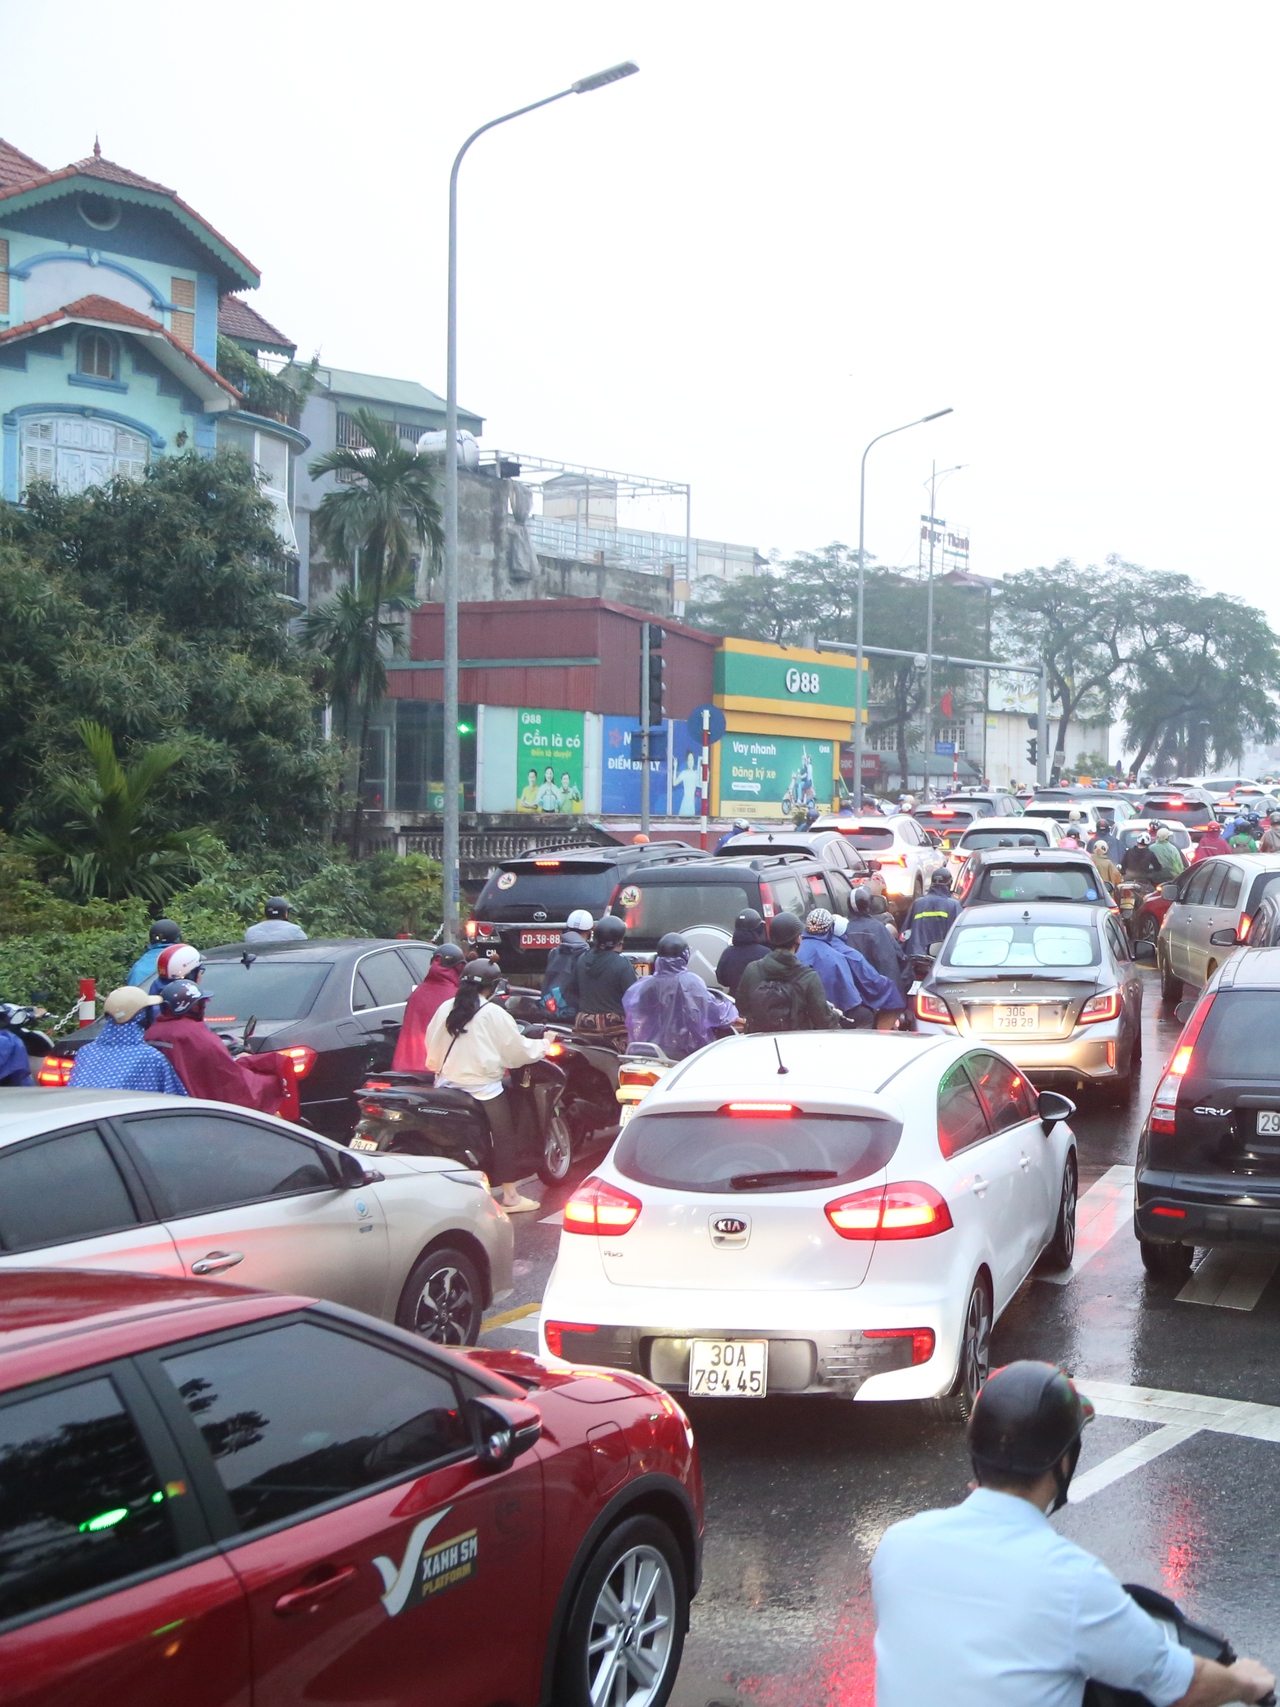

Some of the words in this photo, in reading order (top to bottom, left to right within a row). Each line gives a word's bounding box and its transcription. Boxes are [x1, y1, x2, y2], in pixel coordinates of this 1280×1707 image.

[786, 668, 819, 693] F88
[522, 712, 541, 724] F88
[523, 728, 548, 746] Cần
[552, 733, 562, 747] là
[566, 734, 580, 748] có
[733, 741, 748, 756] Vay
[751, 743, 776, 755] nhanh
[608, 754, 631, 770] ĐIỂM
[732, 766, 753, 780] Đăng
[756, 767, 765, 780] ký
[522, 934, 561, 945] CD-38-88
[1006, 1007, 1025, 1016] 30G
[998, 1018, 1033, 1027] 738.28
[717, 1221, 741, 1231] KIA
[711, 1345, 746, 1366] 30A
[423, 1544, 458, 1580] XANH
[461, 1535, 478, 1562] SM
[422, 1562, 471, 1597] PLATFORM
